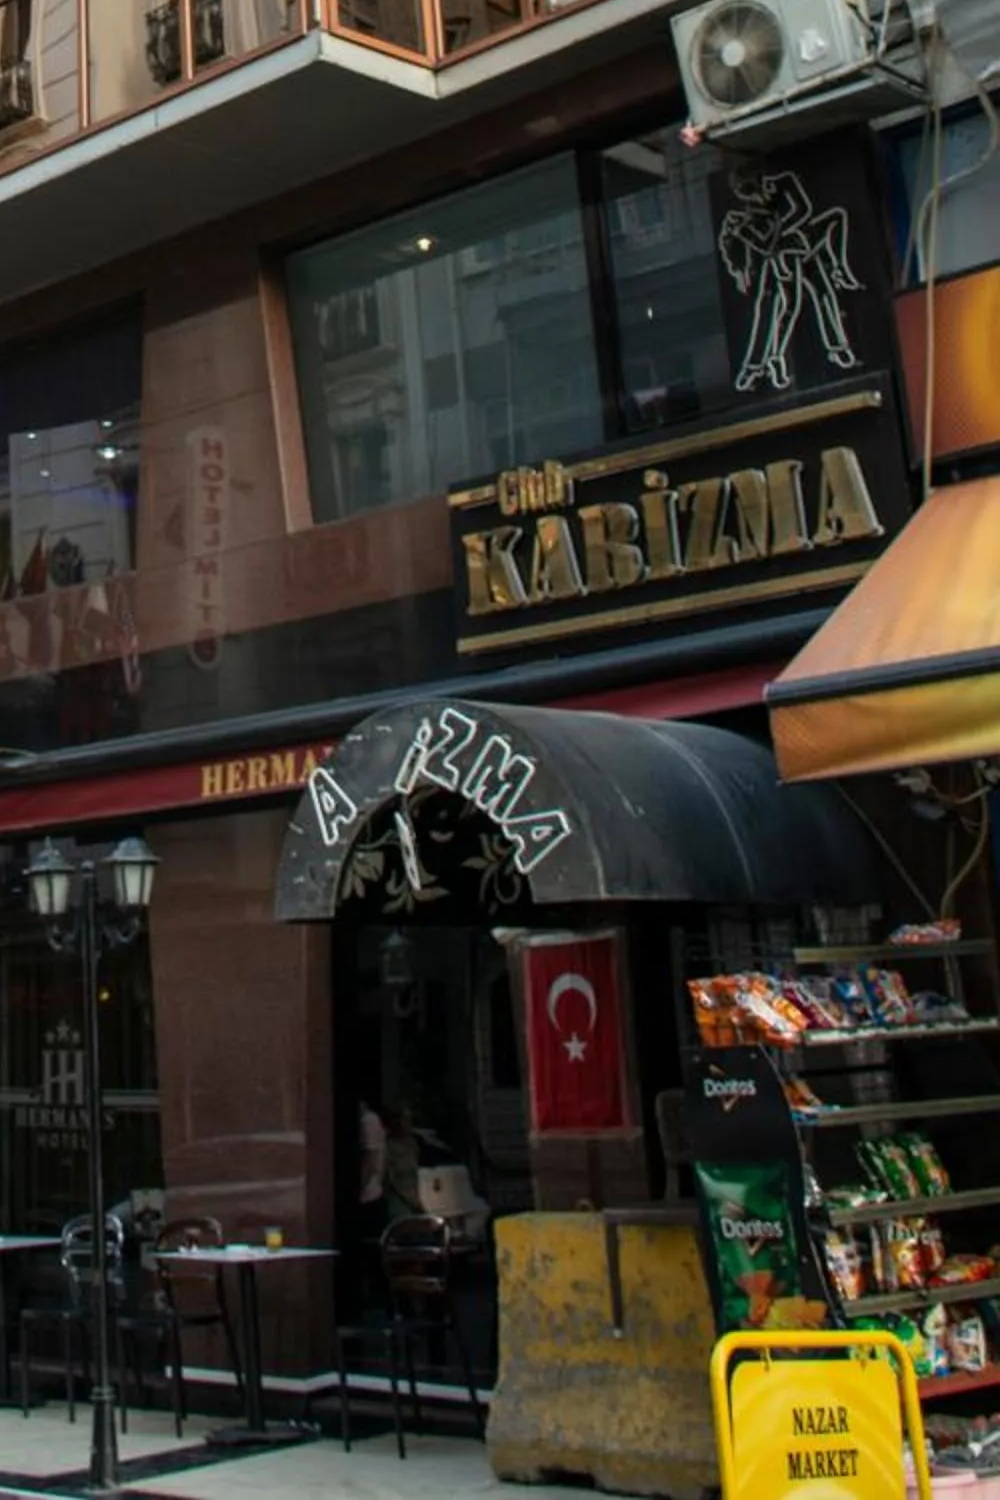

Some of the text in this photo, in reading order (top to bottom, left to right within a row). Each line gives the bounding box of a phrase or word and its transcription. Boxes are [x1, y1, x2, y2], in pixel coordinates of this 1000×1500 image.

[201, 745, 334, 797] HERMA
[704, 1078, 757, 1098] Doritos
[15, 1106, 116, 1131] HERMANS
[721, 1217, 784, 1240] Doritos
[792, 1405, 849, 1436] NAZAR
[786, 1448, 858, 1481] MARKET
